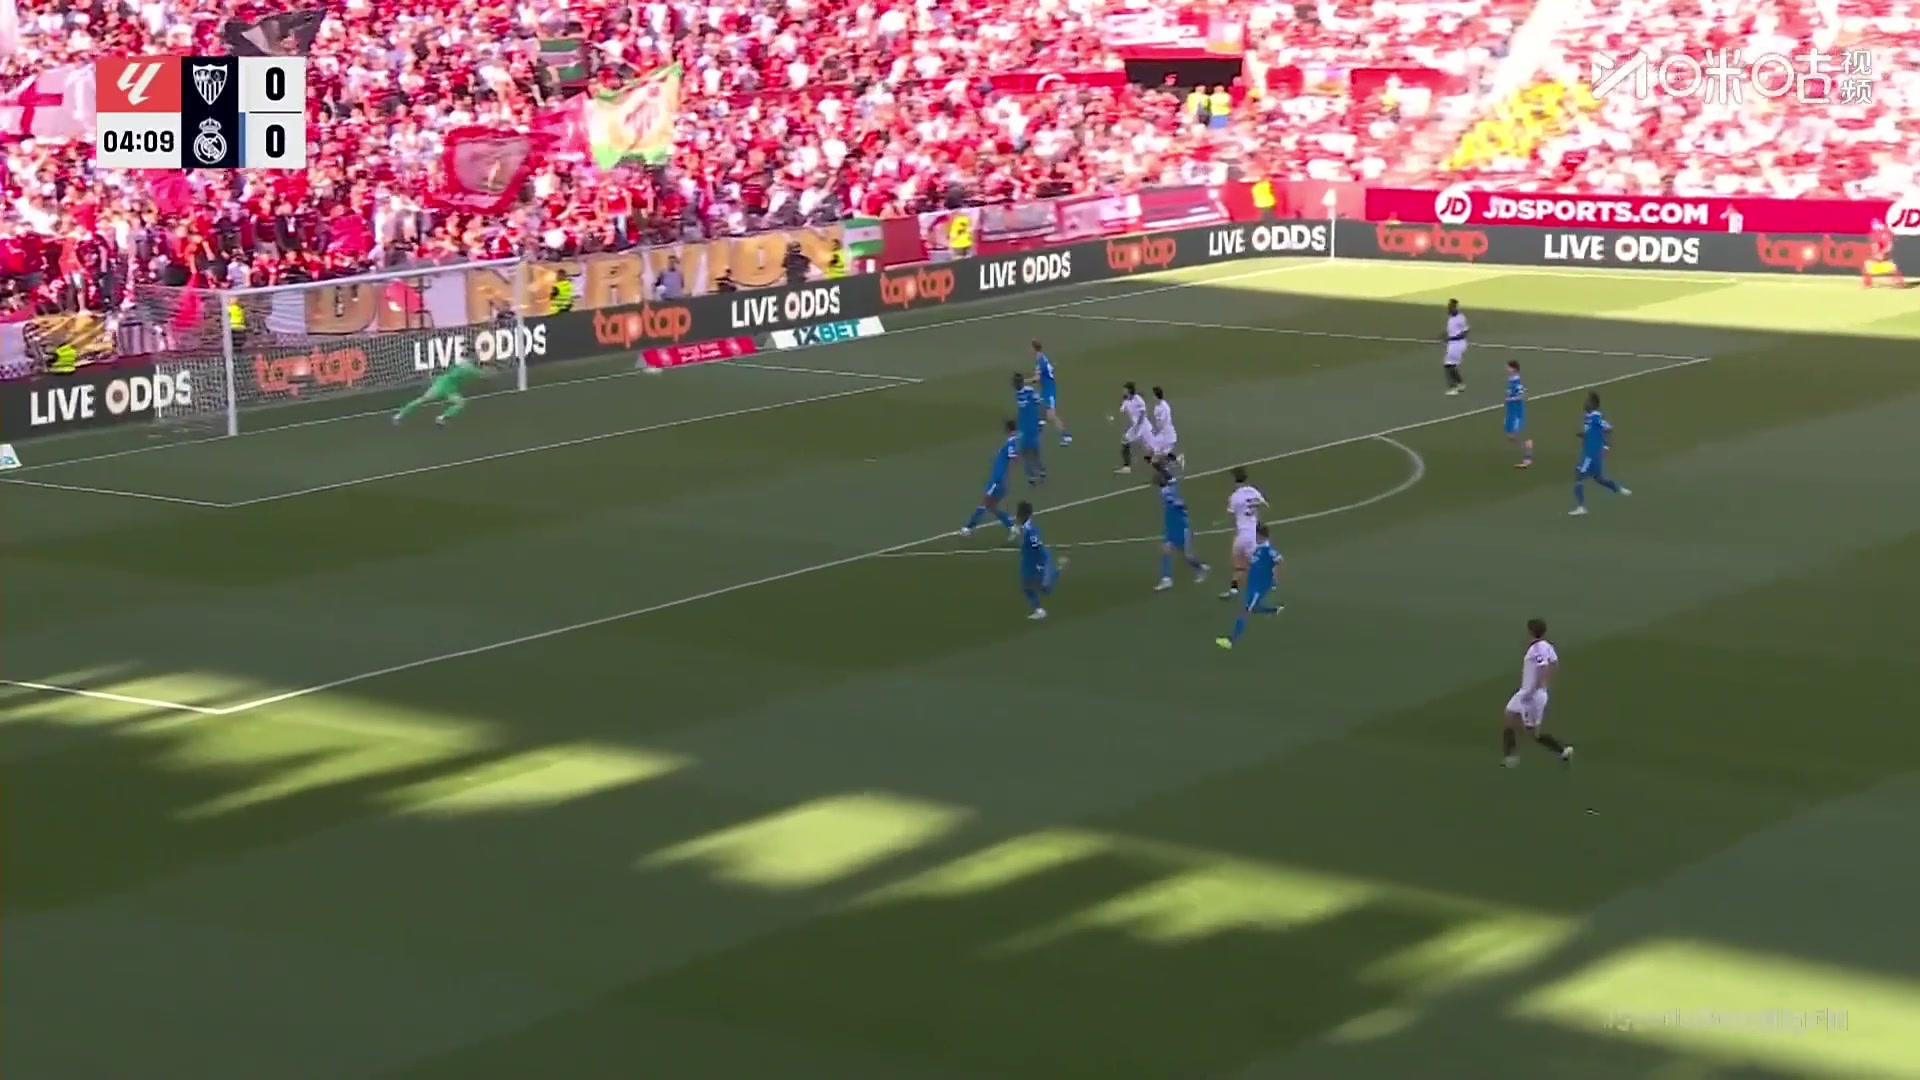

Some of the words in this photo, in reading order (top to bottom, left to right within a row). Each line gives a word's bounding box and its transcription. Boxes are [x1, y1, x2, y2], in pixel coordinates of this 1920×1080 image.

[1440, 197, 1467, 215] JD
[1482, 196, 1709, 224] JDSPORTS.COM
[1209, 228, 1246, 257] LIVE
[1251, 225, 1327, 251] ODDS
[1544, 233, 1604, 260] LIVE
[1615, 236, 1700, 264] ODDS
[1757, 233, 1869, 272] tapta
[979, 259, 1017, 291] LIVE
[1022, 251, 1072, 284] ODDS
[592, 303, 692, 349] taptap
[731, 295, 779, 329] LIVE
[784, 285, 841, 320] ODDS
[414, 336, 466, 371] LIVE
[475, 323, 547, 362] ODDS
[30, 384, 95, 426] LIVE
[105, 370, 192, 415] ODDS
